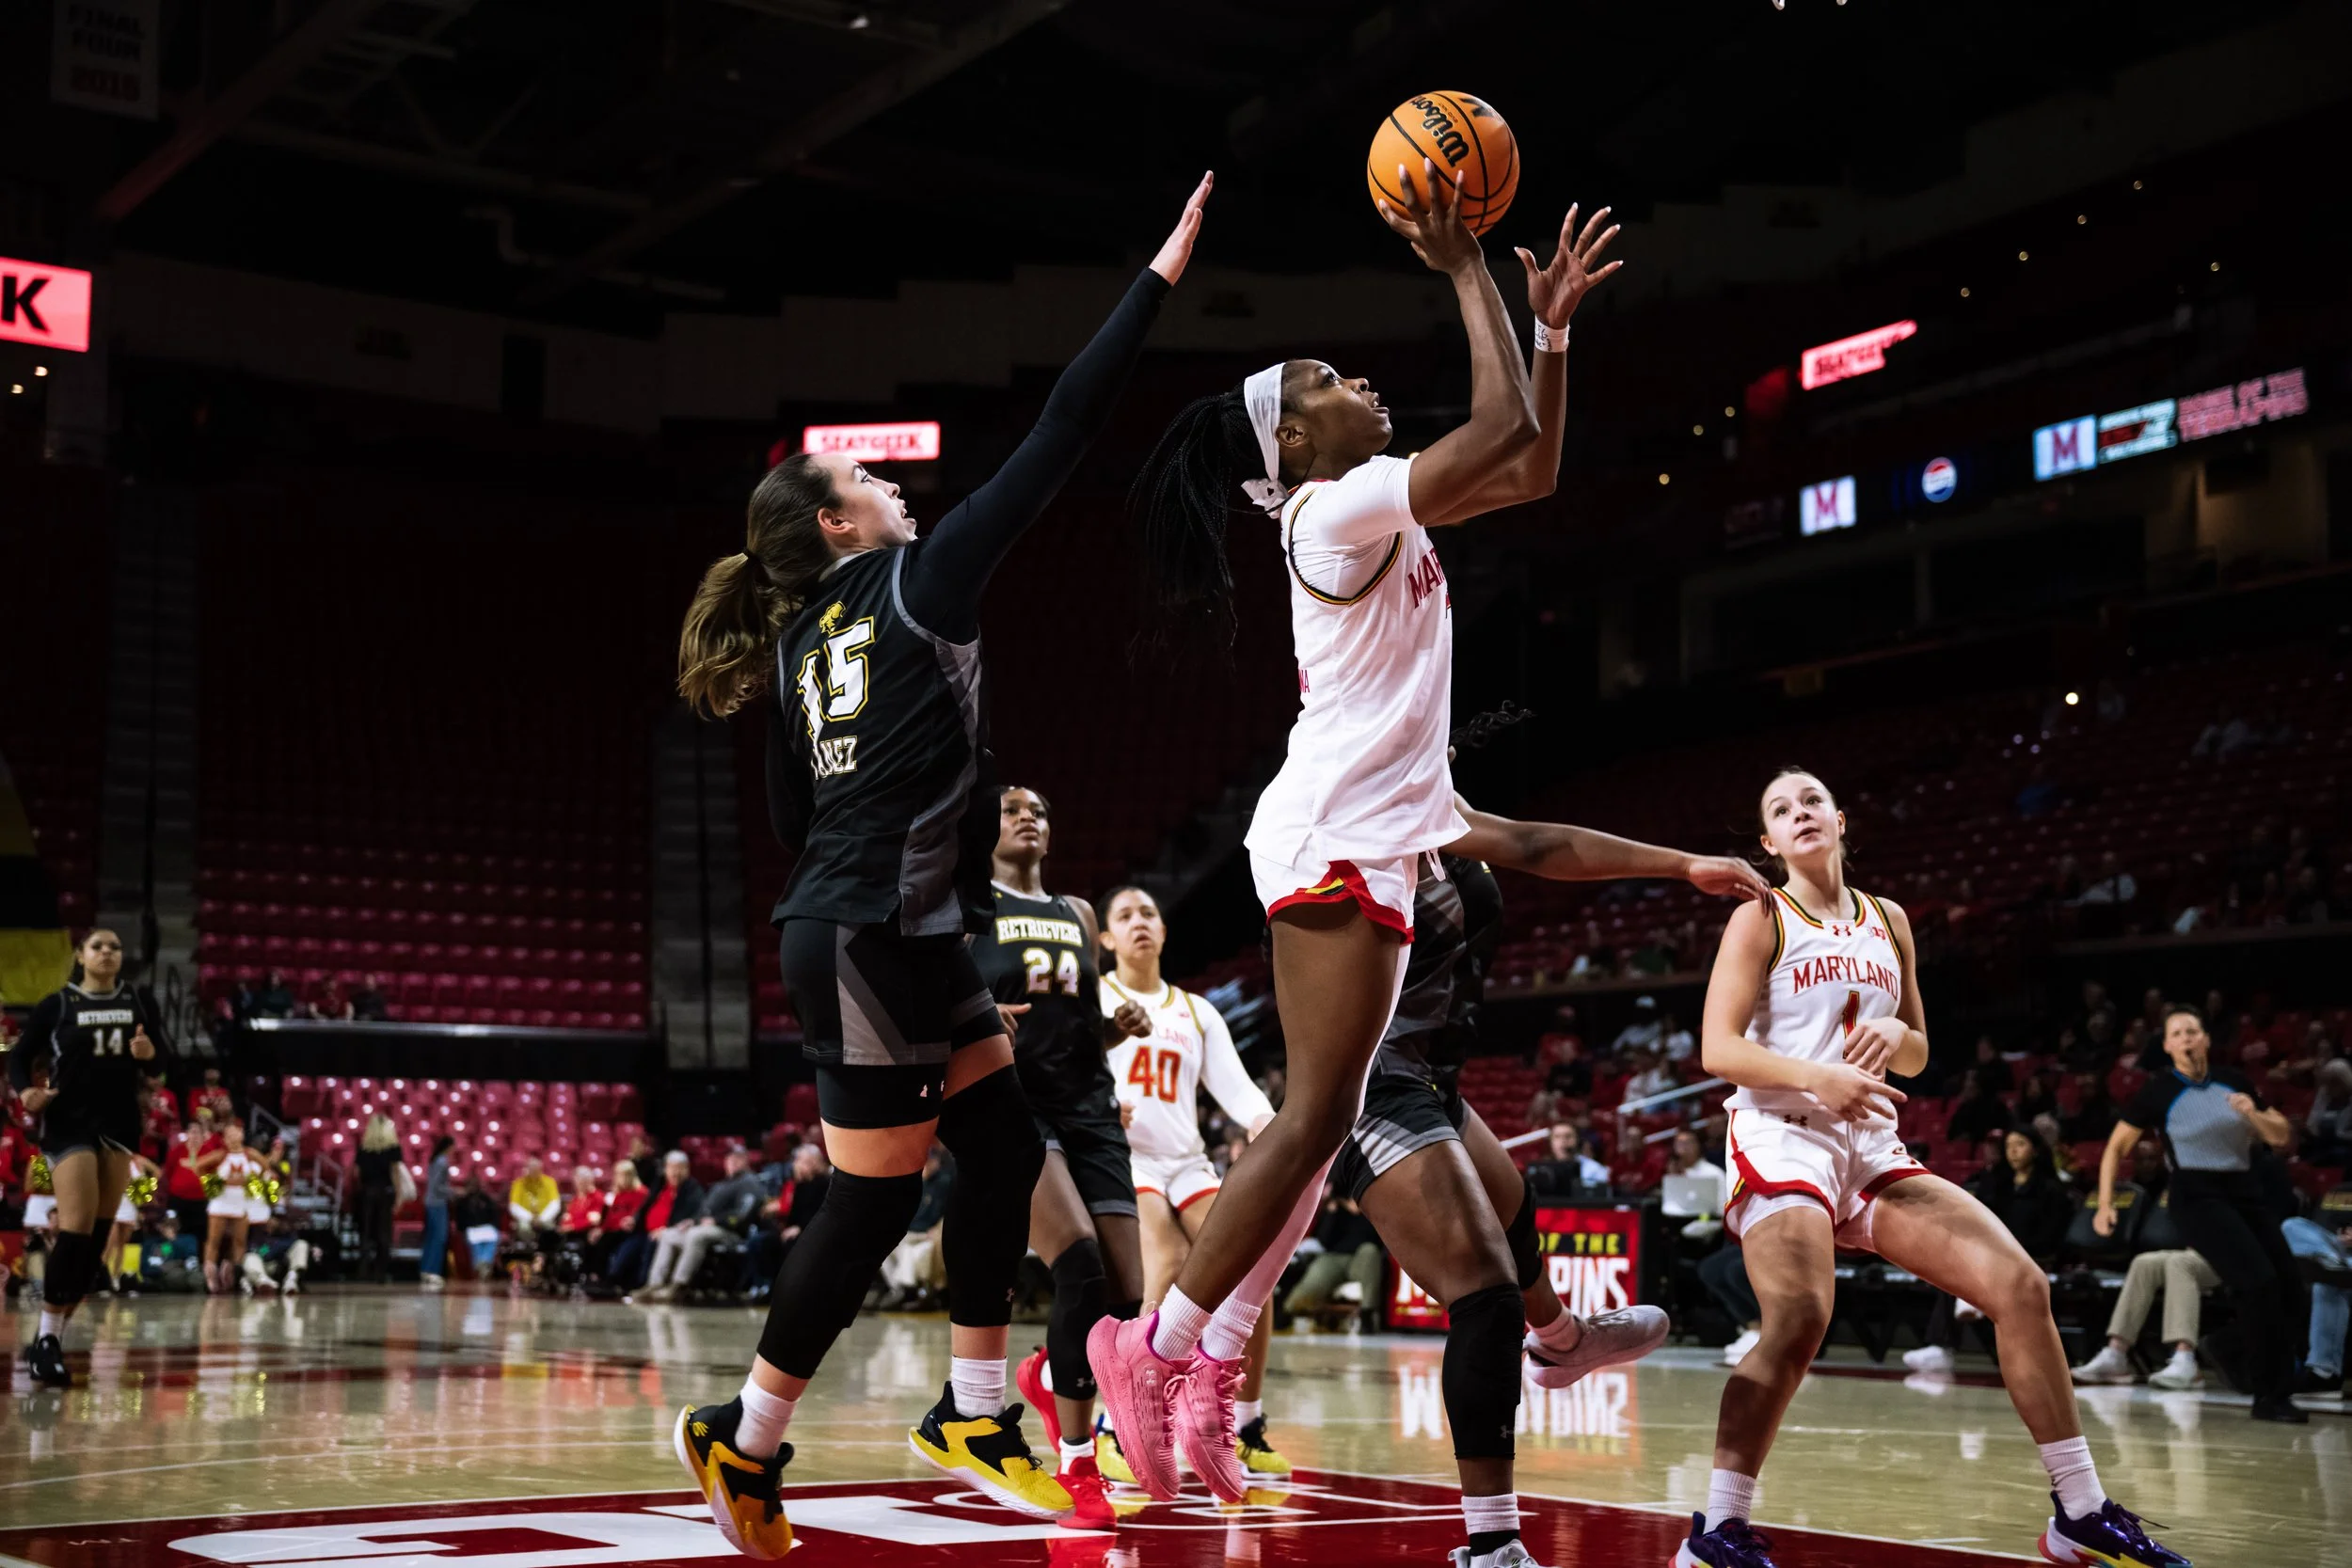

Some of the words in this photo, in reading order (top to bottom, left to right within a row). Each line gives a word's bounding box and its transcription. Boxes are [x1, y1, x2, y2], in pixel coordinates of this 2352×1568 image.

[1410, 95, 1470, 167] Wilson
[2, 275, 51, 333] K
[797, 616, 876, 743] 15
[995, 916, 1083, 948] RETRIEVERS
[1022, 947, 1080, 999] 24
[1793, 956, 1899, 1002] MARYLAND
[93, 1028, 123, 1056] 14
[1843, 990, 1860, 1060] 1
[1128, 1045, 1182, 1104] 40
[1573, 1232, 1621, 1256] THE
